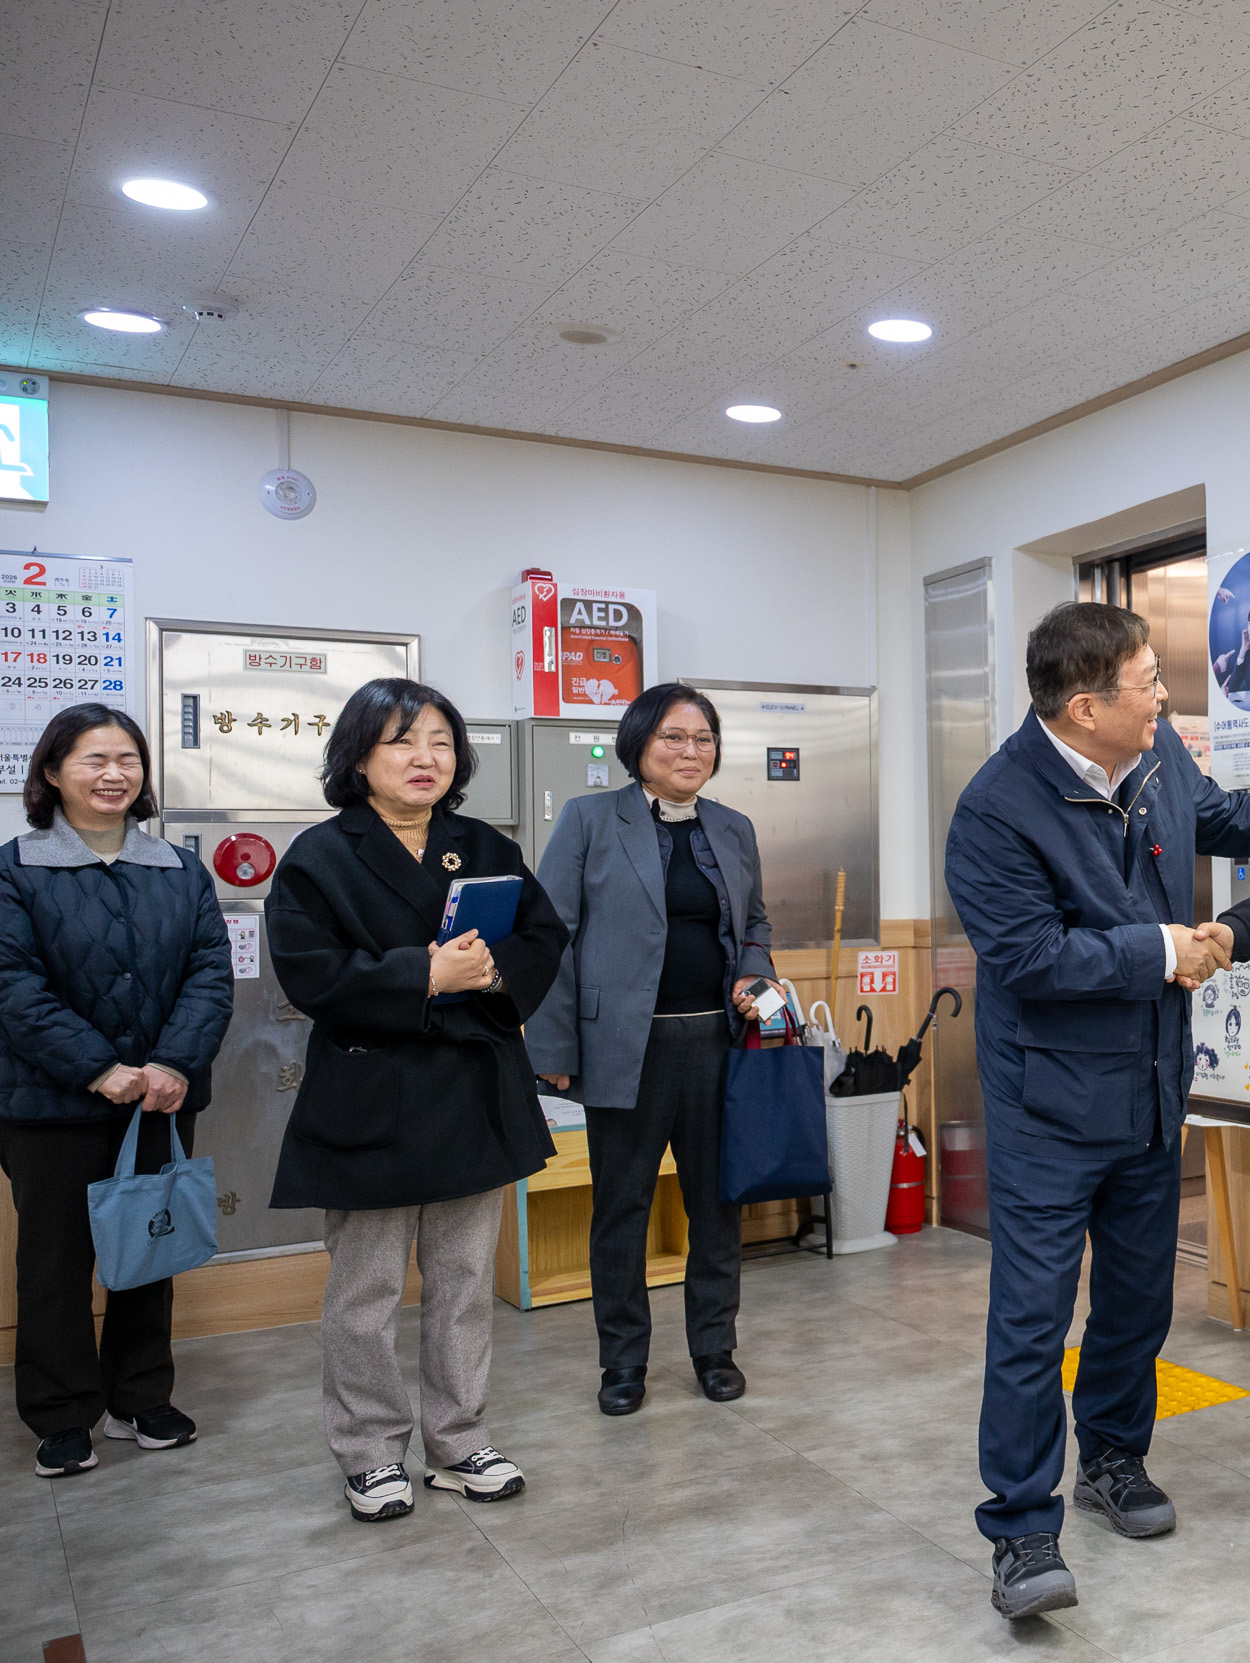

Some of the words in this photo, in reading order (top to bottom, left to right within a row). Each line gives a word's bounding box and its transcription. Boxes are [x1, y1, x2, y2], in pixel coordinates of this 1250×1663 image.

[23, 562, 47, 586] 2
[572, 587, 626, 600] 심장마비환자용
[5, 602, 17, 613] 3
[31, 604, 42, 615] 4
[56, 605, 67, 616] 5
[81, 607, 92, 617] 6
[106, 608, 117, 619] 7
[512, 605, 526, 627] AED
[569, 601, 629, 627] AED
[0, 627, 22, 638] 10
[28, 628, 46, 639] 11
[52, 630, 73, 641] 12
[77, 631, 97, 642] 13
[102, 632, 122, 643] 14
[0, 652, 22, 662] 17
[27, 653, 47, 664] 18
[52, 654, 73, 665] 19
[77, 655, 98, 666] 20
[103, 656, 122, 667] 21
[248, 653, 323, 671] 방수기구함
[0, 676, 23, 687] 24
[27, 677, 48, 688] 25
[53, 678, 73, 689] 26
[77, 679, 98, 690] 27
[102, 679, 123, 691] 28
[861, 954, 896, 964] 소화기
